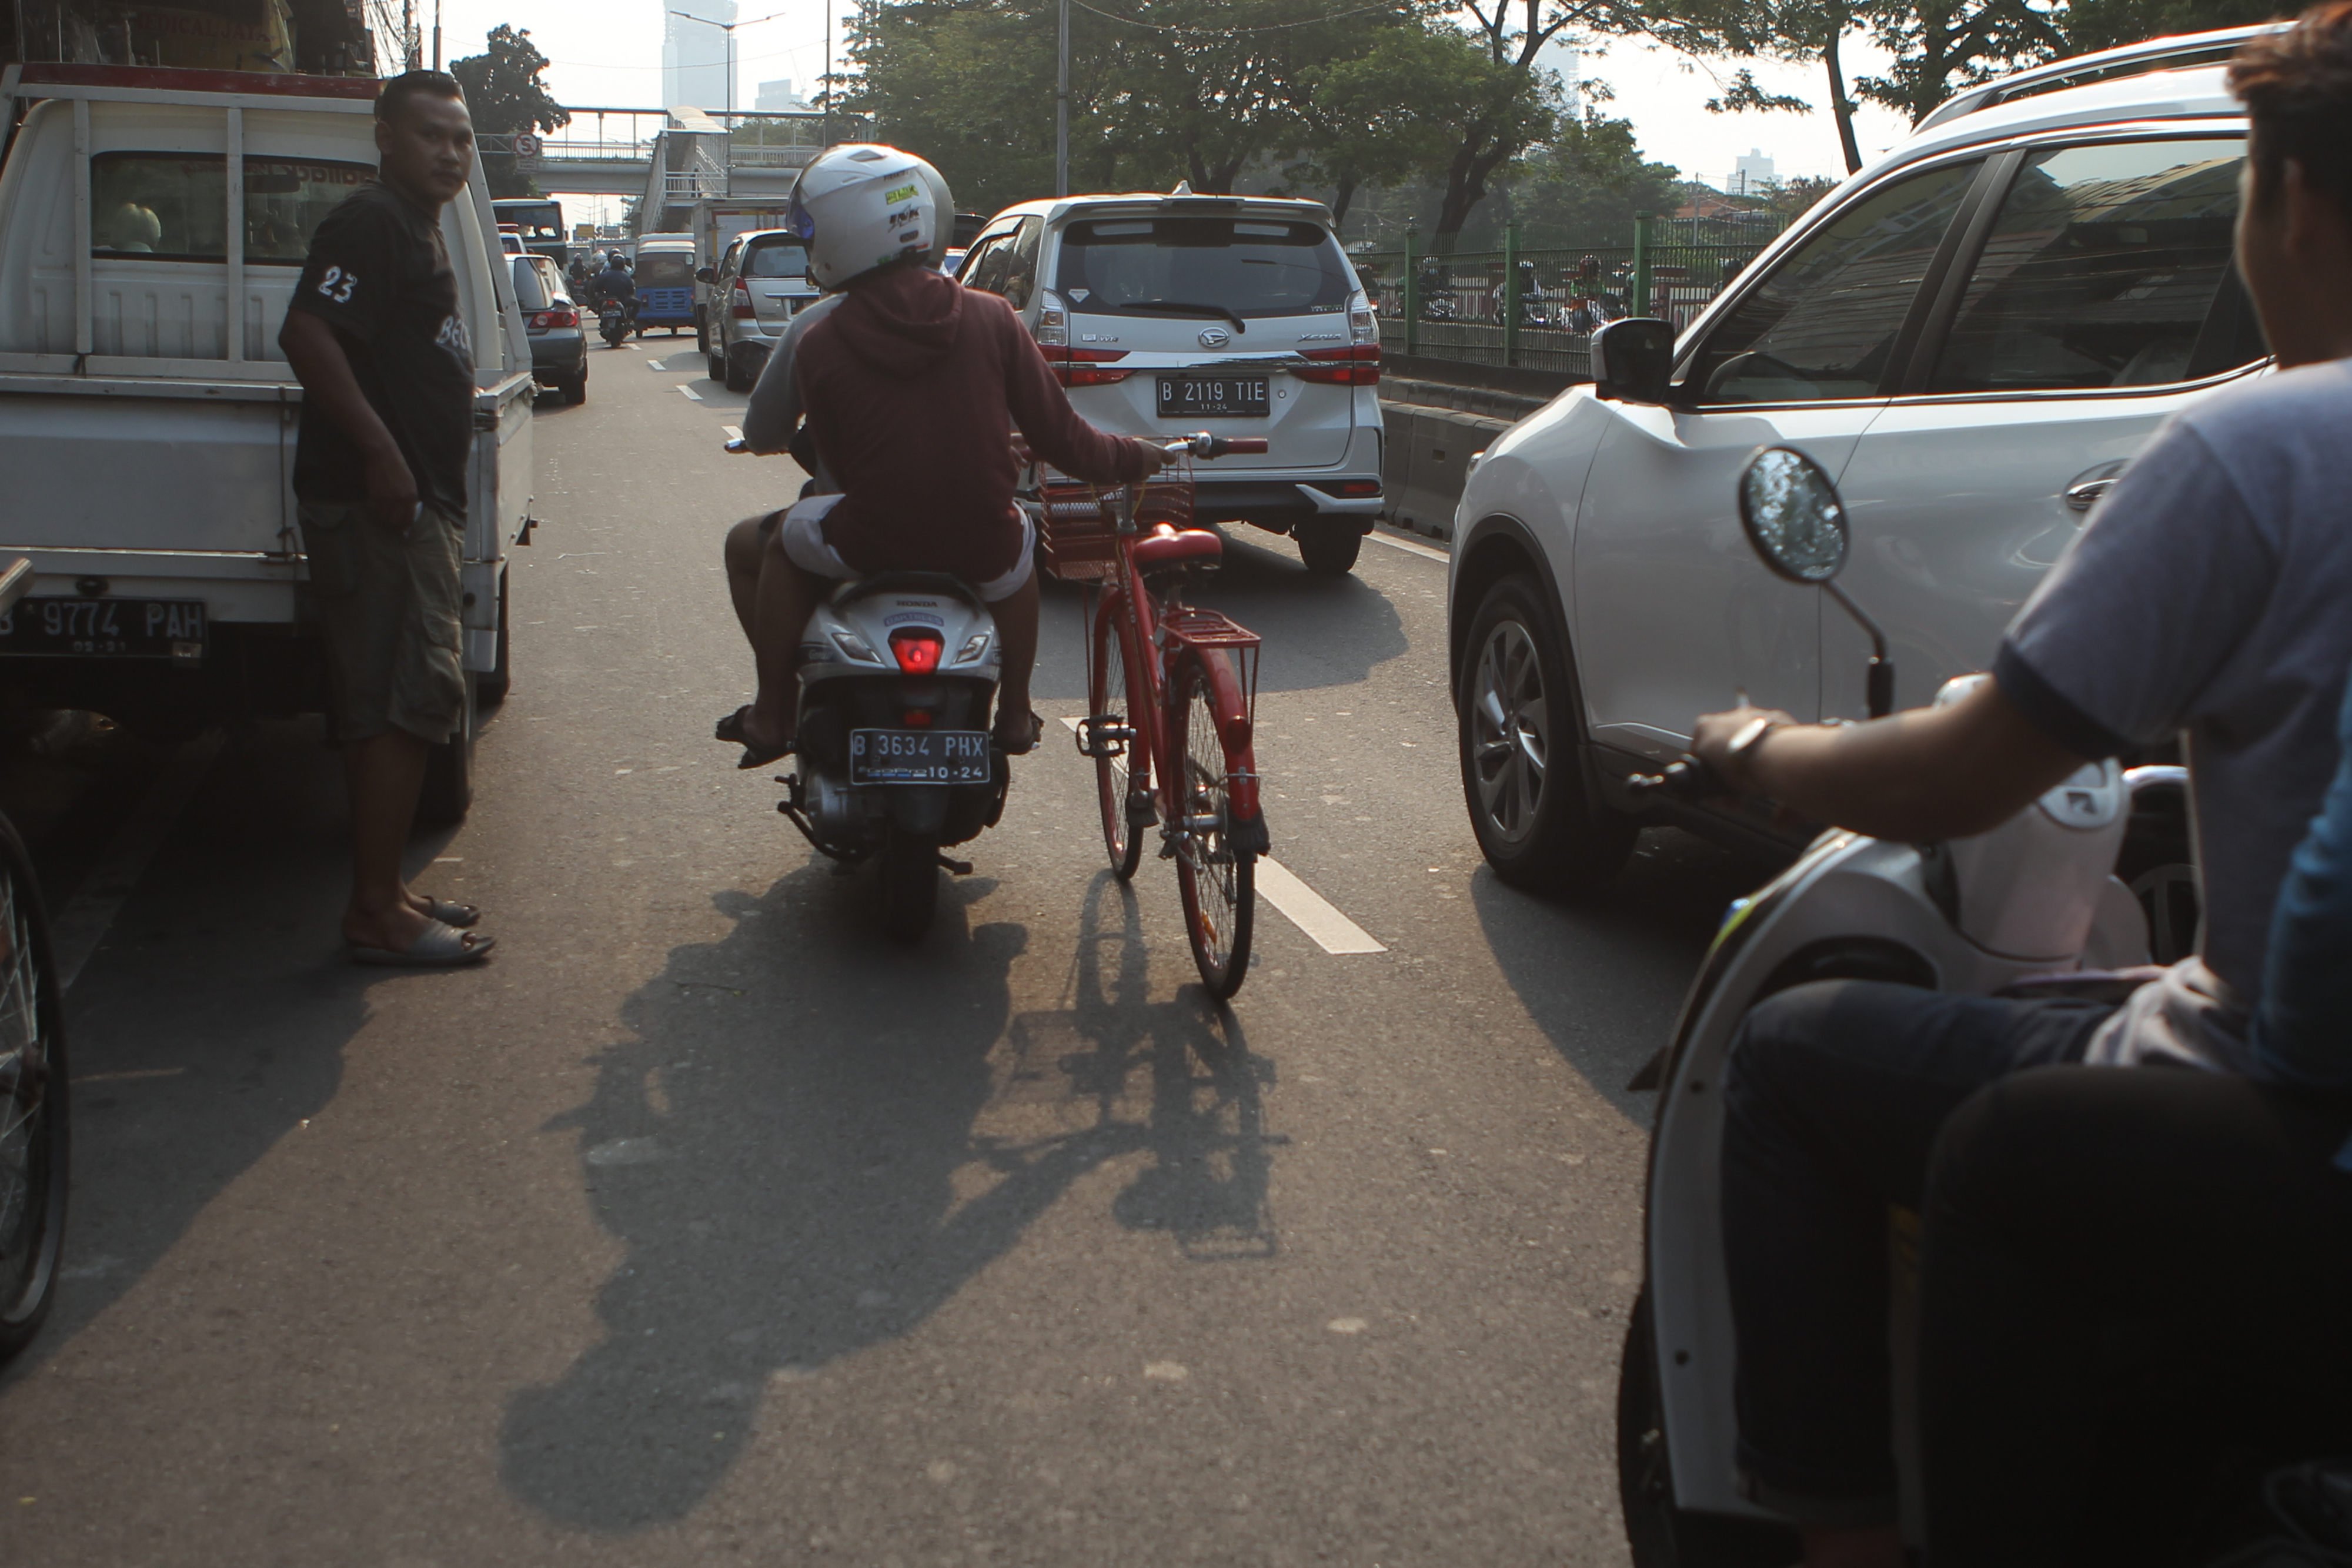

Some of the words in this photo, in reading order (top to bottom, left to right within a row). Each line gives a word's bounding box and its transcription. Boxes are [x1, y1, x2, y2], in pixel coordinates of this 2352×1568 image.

[318, 265, 358, 303] 23
[1162, 382, 1172, 401] B
[1185, 382, 1224, 401] 2119
[1235, 382, 1265, 400] TIE
[43, 602, 120, 637] 9774
[146, 603, 203, 638] PAH
[854, 735, 865, 755] B
[878, 735, 930, 755] 3634
[946, 737, 984, 757] PHX
